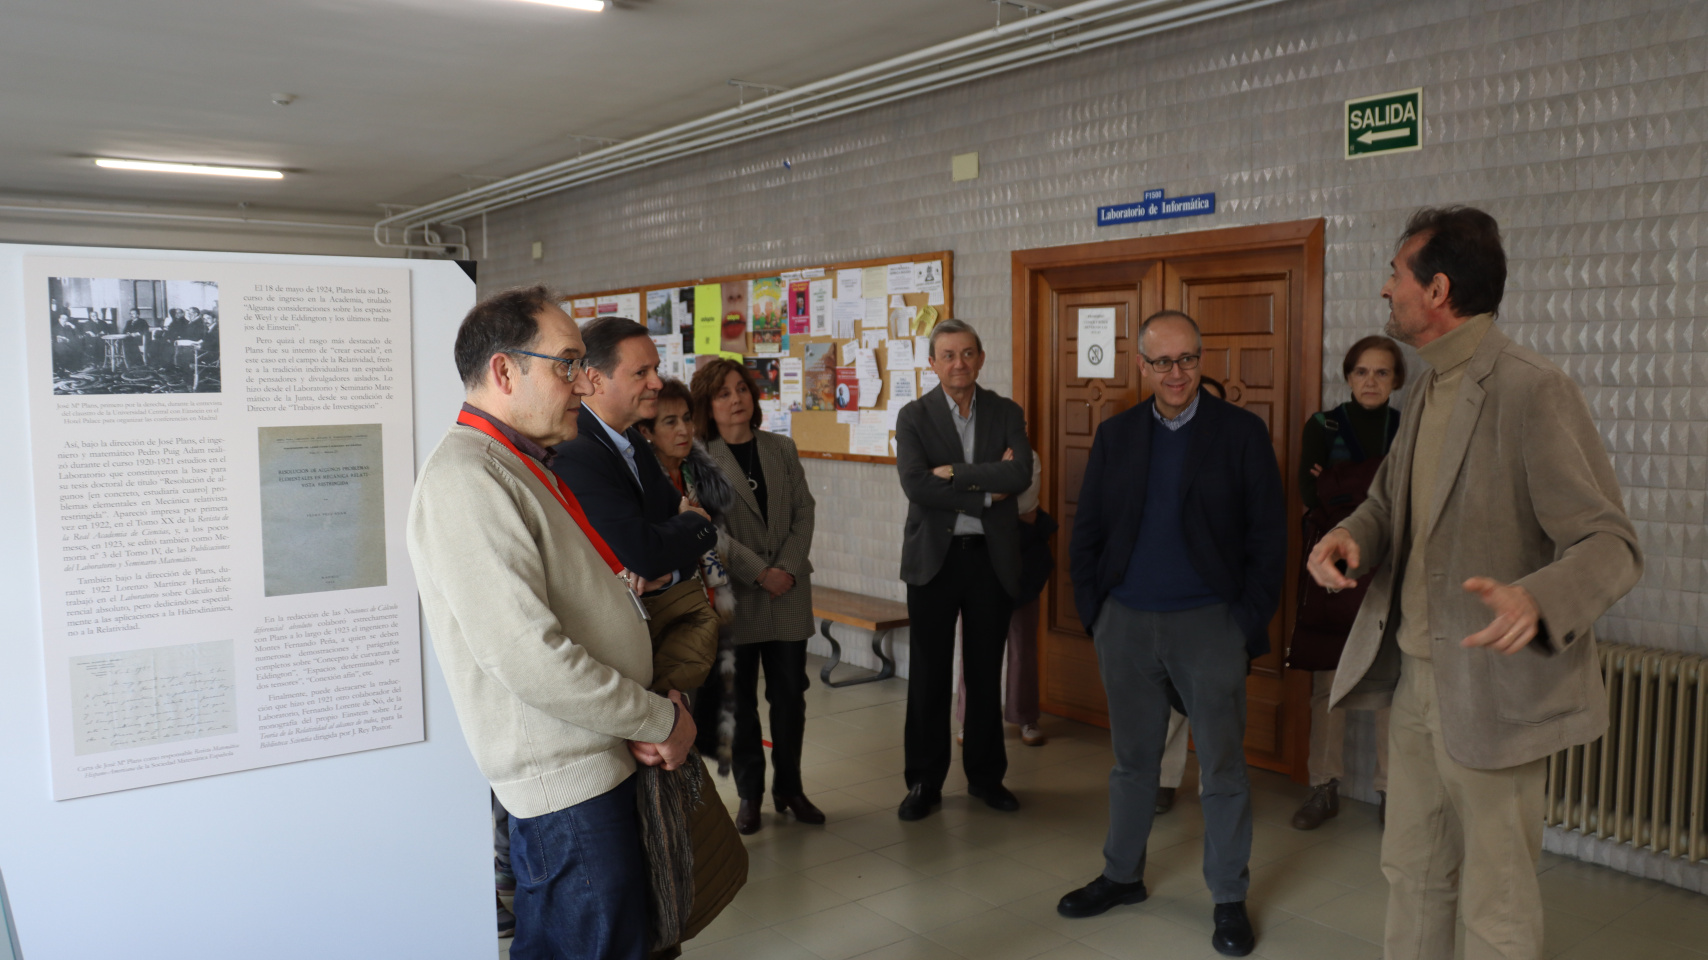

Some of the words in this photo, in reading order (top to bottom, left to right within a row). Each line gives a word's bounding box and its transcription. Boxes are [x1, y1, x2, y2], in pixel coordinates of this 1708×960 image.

[1350, 101, 1416, 129] SALIDA
[1101, 205, 1145, 220] Laboratorio
[1149, 204, 1158, 214] de
[1162, 198, 1209, 213] Informática
[279, 295, 304, 304] ingreso
[364, 306, 391, 314] espacios
[258, 375, 297, 384] pensadores
[308, 375, 350, 383] divulgadores
